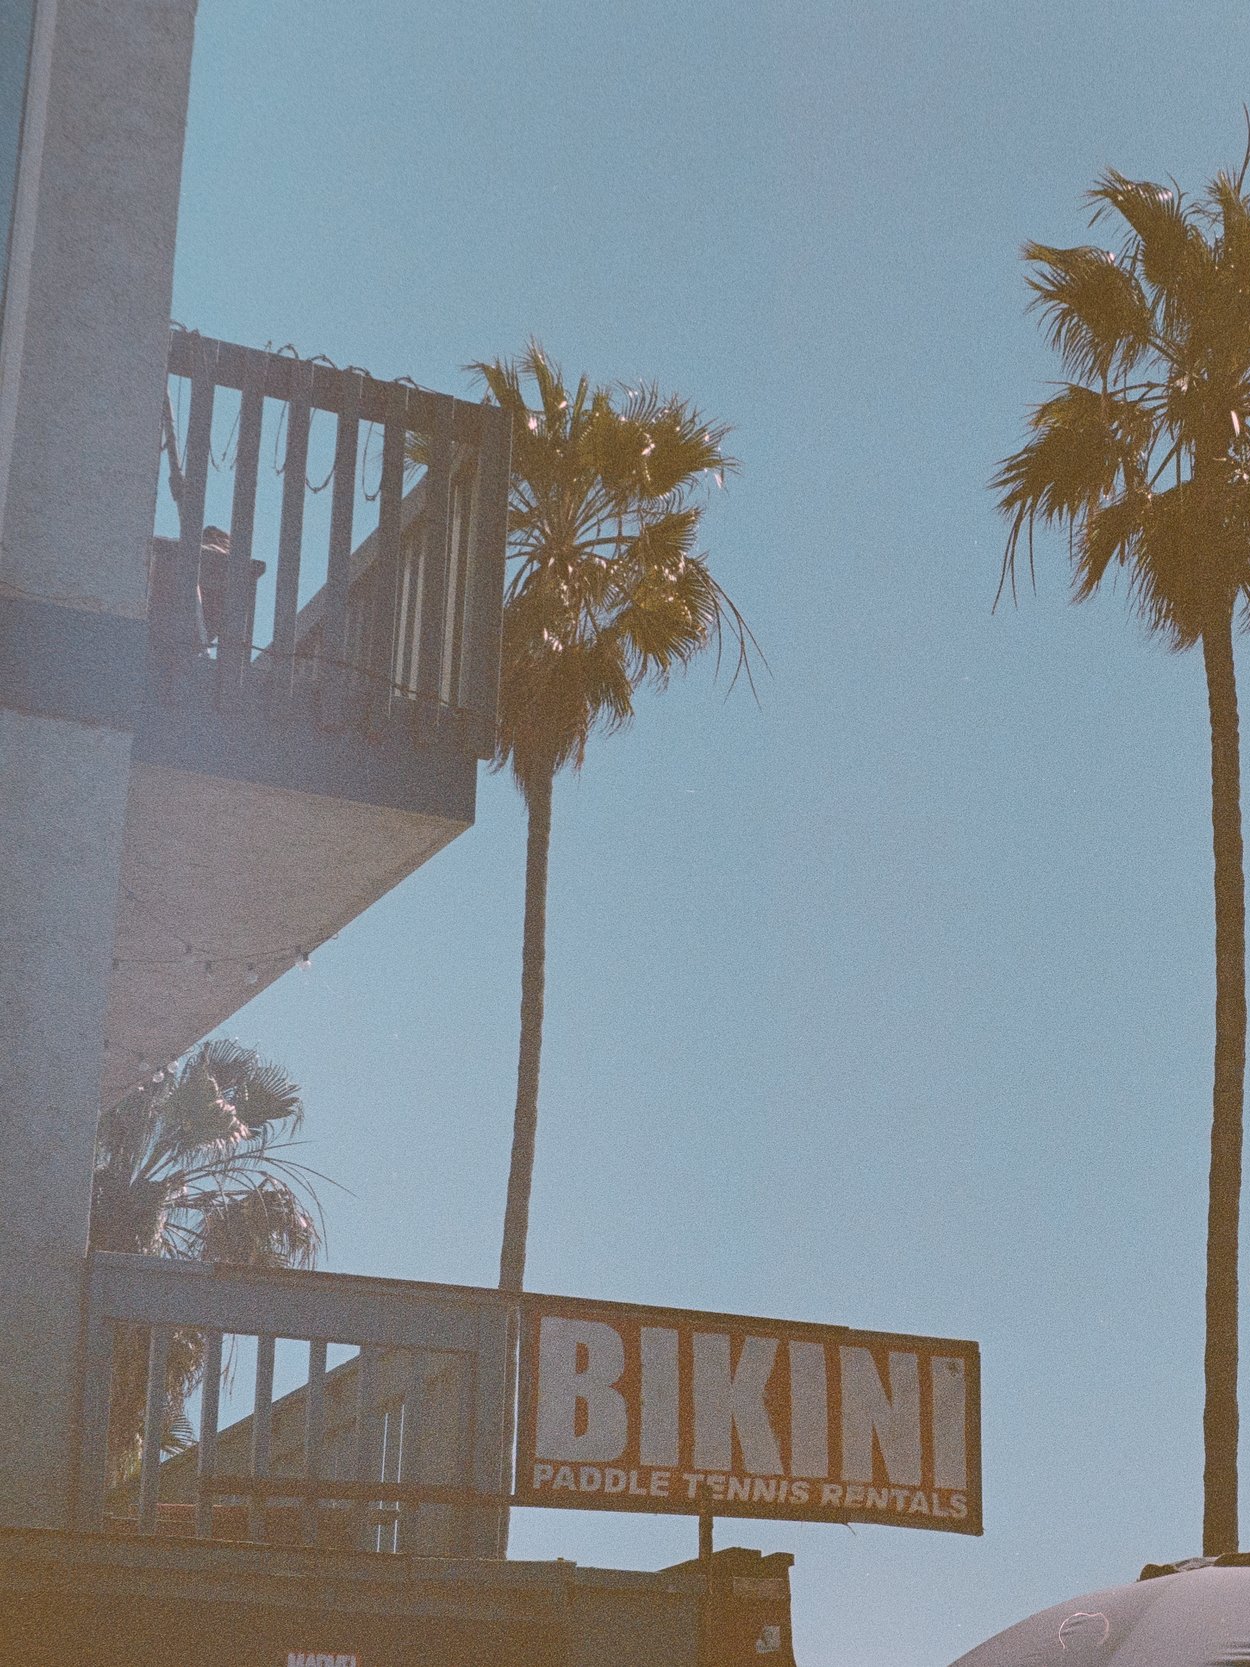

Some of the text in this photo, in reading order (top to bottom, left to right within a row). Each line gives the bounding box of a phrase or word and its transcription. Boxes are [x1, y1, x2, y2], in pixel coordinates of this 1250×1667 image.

[534, 1315, 968, 1491] BIKINI
[532, 1463, 969, 1519] PADDLE TENNIS RENTALS
